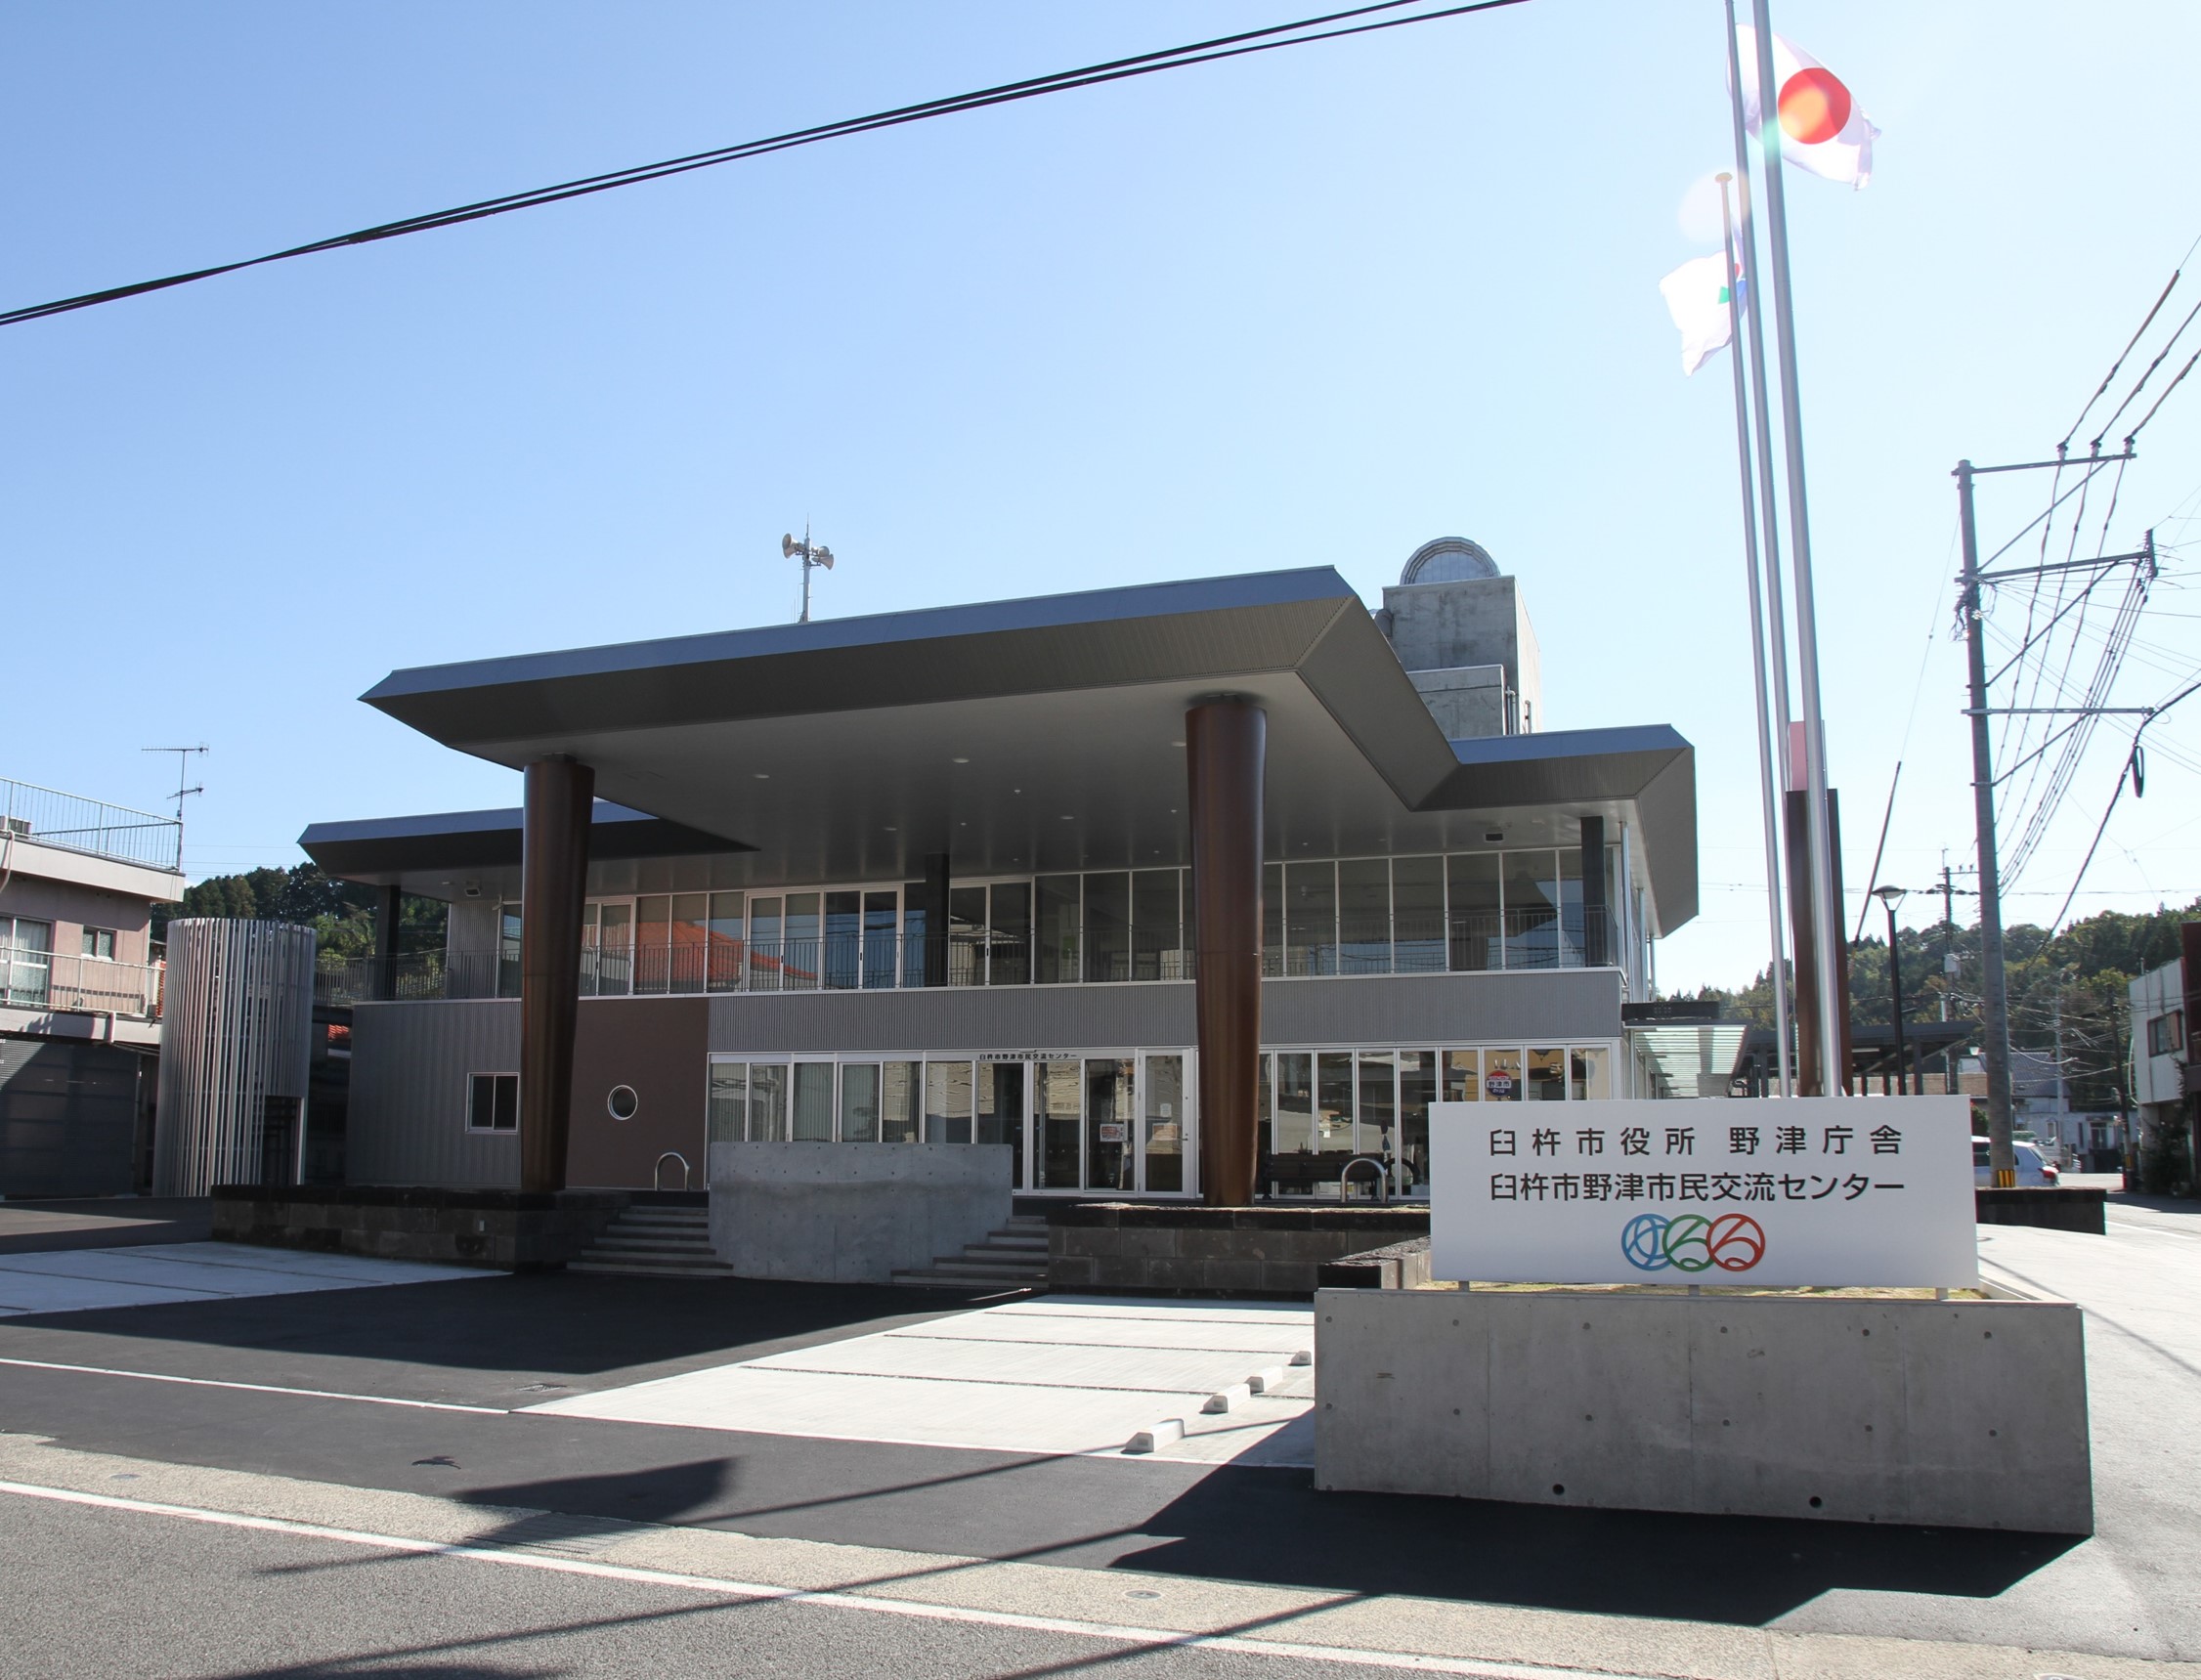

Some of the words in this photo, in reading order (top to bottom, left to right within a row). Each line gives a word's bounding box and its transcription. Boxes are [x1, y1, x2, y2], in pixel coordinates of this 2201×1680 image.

[1489, 1127, 1695, 1156] 臼杵市役所
[1729, 1125, 1902, 1155] 野津庁舎
[1490, 1172, 1905, 1201] 臼杵市野津市民交流センター
